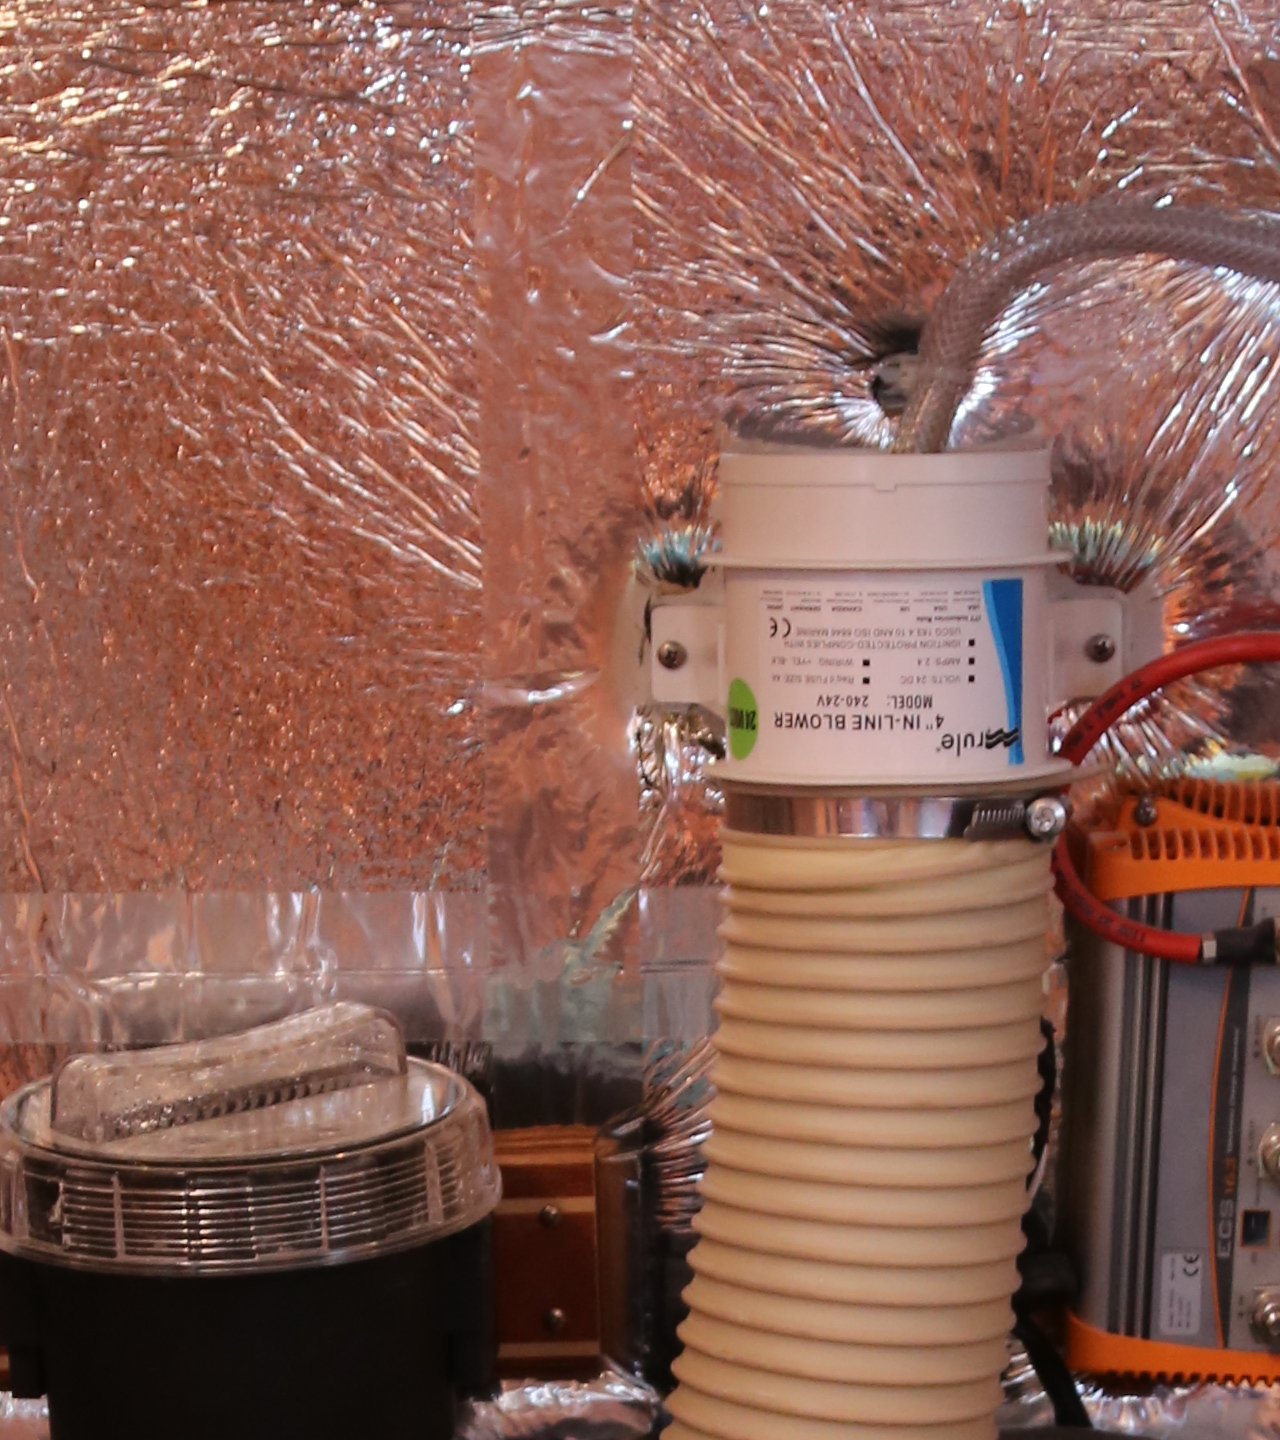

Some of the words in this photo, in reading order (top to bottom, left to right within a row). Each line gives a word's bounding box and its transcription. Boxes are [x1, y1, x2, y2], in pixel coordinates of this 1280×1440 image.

[817, 695, 869, 707] 240-24V
[887, 694, 933, 709] MODEL:
[774, 711, 845, 730] BLOWER
[852, 713, 921, 730] IN-LINE
[1217, 1199, 1234, 1258] ECS
